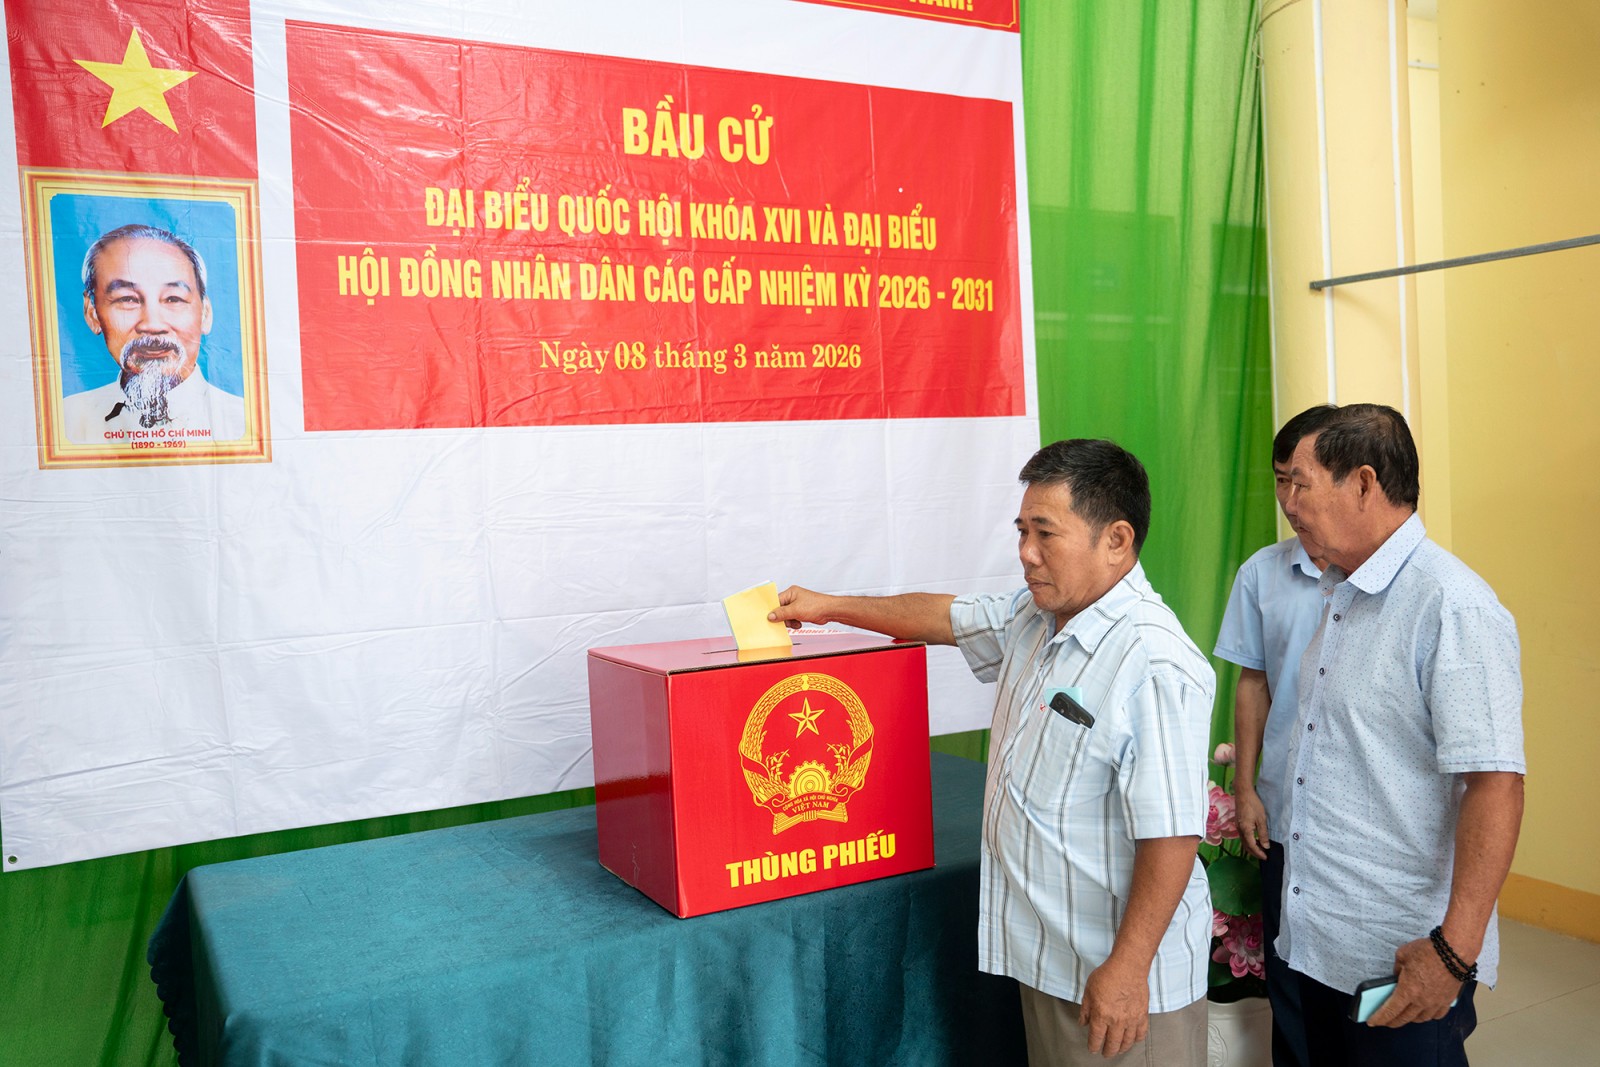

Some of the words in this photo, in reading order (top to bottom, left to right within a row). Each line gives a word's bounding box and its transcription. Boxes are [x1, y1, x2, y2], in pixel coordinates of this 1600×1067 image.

[622, 94, 705, 160] BẦU
[718, 104, 774, 165] CỬ
[425, 187, 475, 237] ĐẠI
[484, 177, 549, 232] BIỂU
[558, 184, 631, 238] QUỐC
[639, 192, 683, 246] HỘI
[690, 197, 757, 242] KHÓA
[763, 206, 802, 244] XVI
[808, 203, 839, 246] VÀ
[843, 212, 882, 255] ĐẠI
[888, 202, 937, 251] BIỂU
[337, 248, 390, 305] HỘI
[399, 244, 483, 299] ĐỒNG
[492, 253, 571, 301] NHÂN
[580, 256, 636, 302] DÂN
[644, 257, 696, 304] CÁC
[703, 256, 753, 305] CẤP
[759, 264, 838, 315] NHIỆM
[844, 266, 872, 308] KỲ
[878, 274, 931, 310] 2026
[936, 291, 946, 300] -
[951, 277, 994, 312] 2031
[539, 341, 610, 375] Ngày
[614, 341, 647, 370] 08
[653, 341, 728, 375] tháng
[733, 343, 748, 369] 3
[754, 344, 807, 369] năm
[811, 344, 863, 369] 2026
[104, 429, 125, 439] CHỦ
[127, 431, 149, 441] TỊCH
[168, 428, 185, 437] CHÍ
[187, 429, 211, 437] MINH
[131, 441, 155, 450] (1890
[164, 440, 187, 449] 1969)
[792, 801, 811, 813] VIỆT
[812, 801, 830, 809] NAM
[725, 848, 817, 888] THÙNG
[823, 829, 896, 870] PHIẾU
